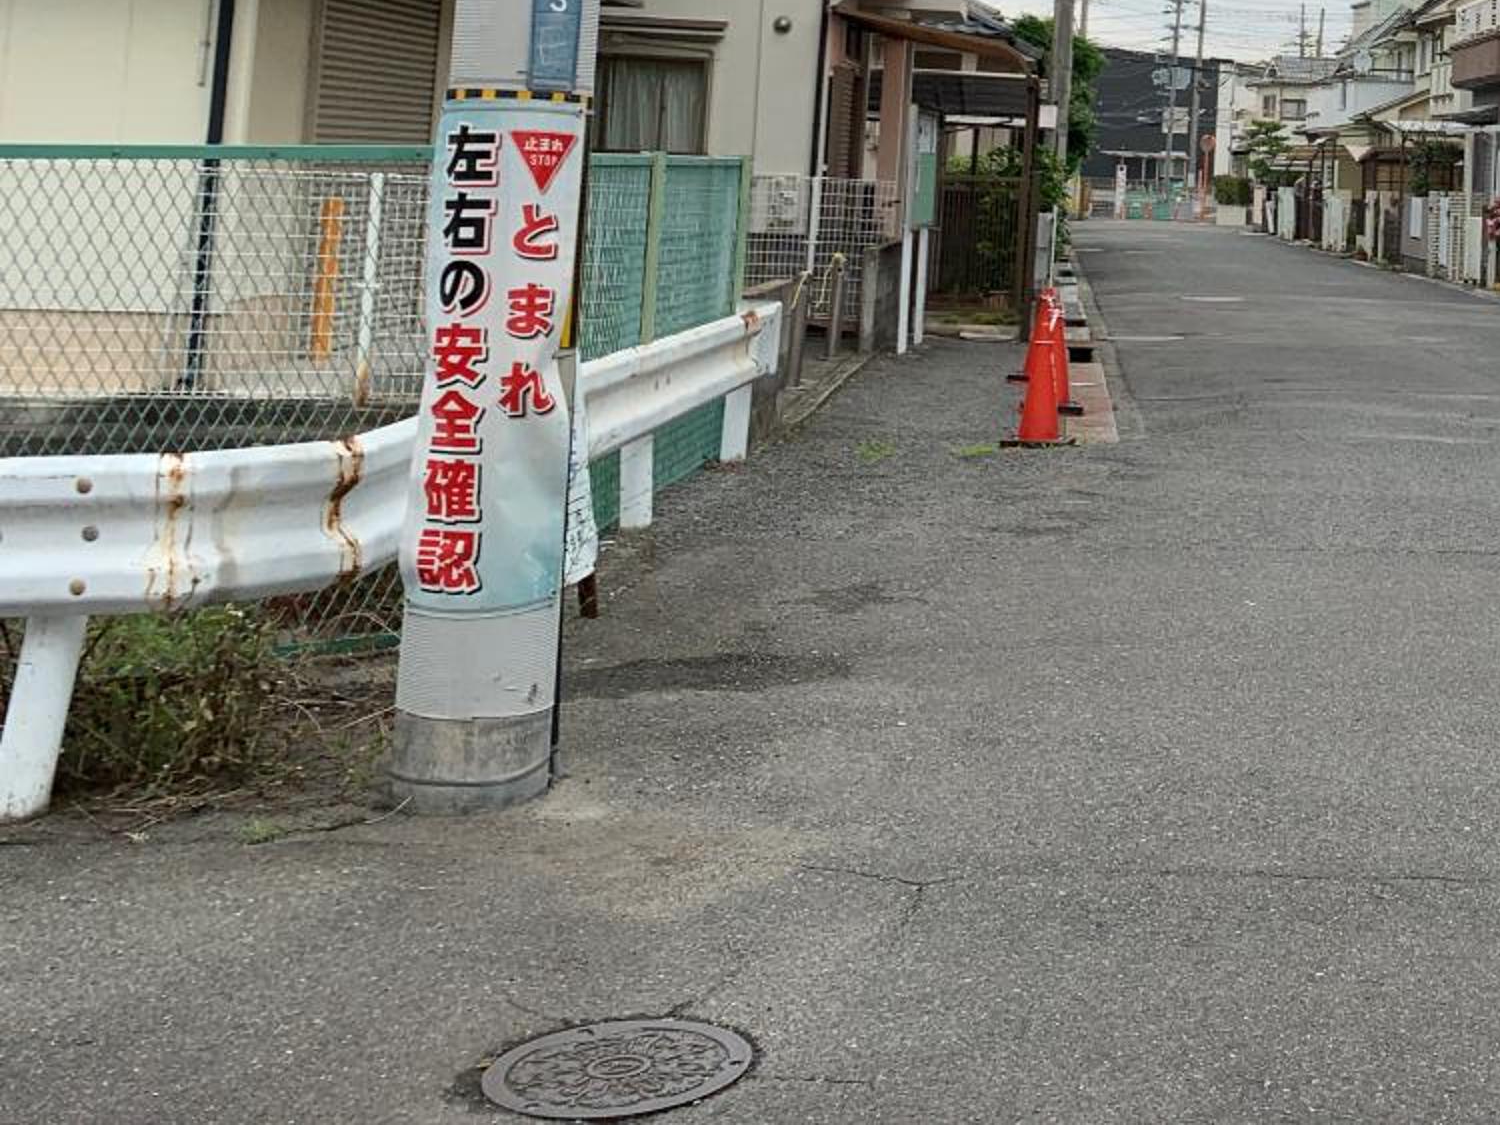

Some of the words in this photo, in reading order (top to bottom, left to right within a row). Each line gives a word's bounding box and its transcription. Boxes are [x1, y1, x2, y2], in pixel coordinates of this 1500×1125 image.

[524, 136, 564, 152] 止まれ
[529, 153, 558, 167] STOP
[416, 125, 501, 594] 左右の安全確認
[499, 204, 558, 417] とまれ
